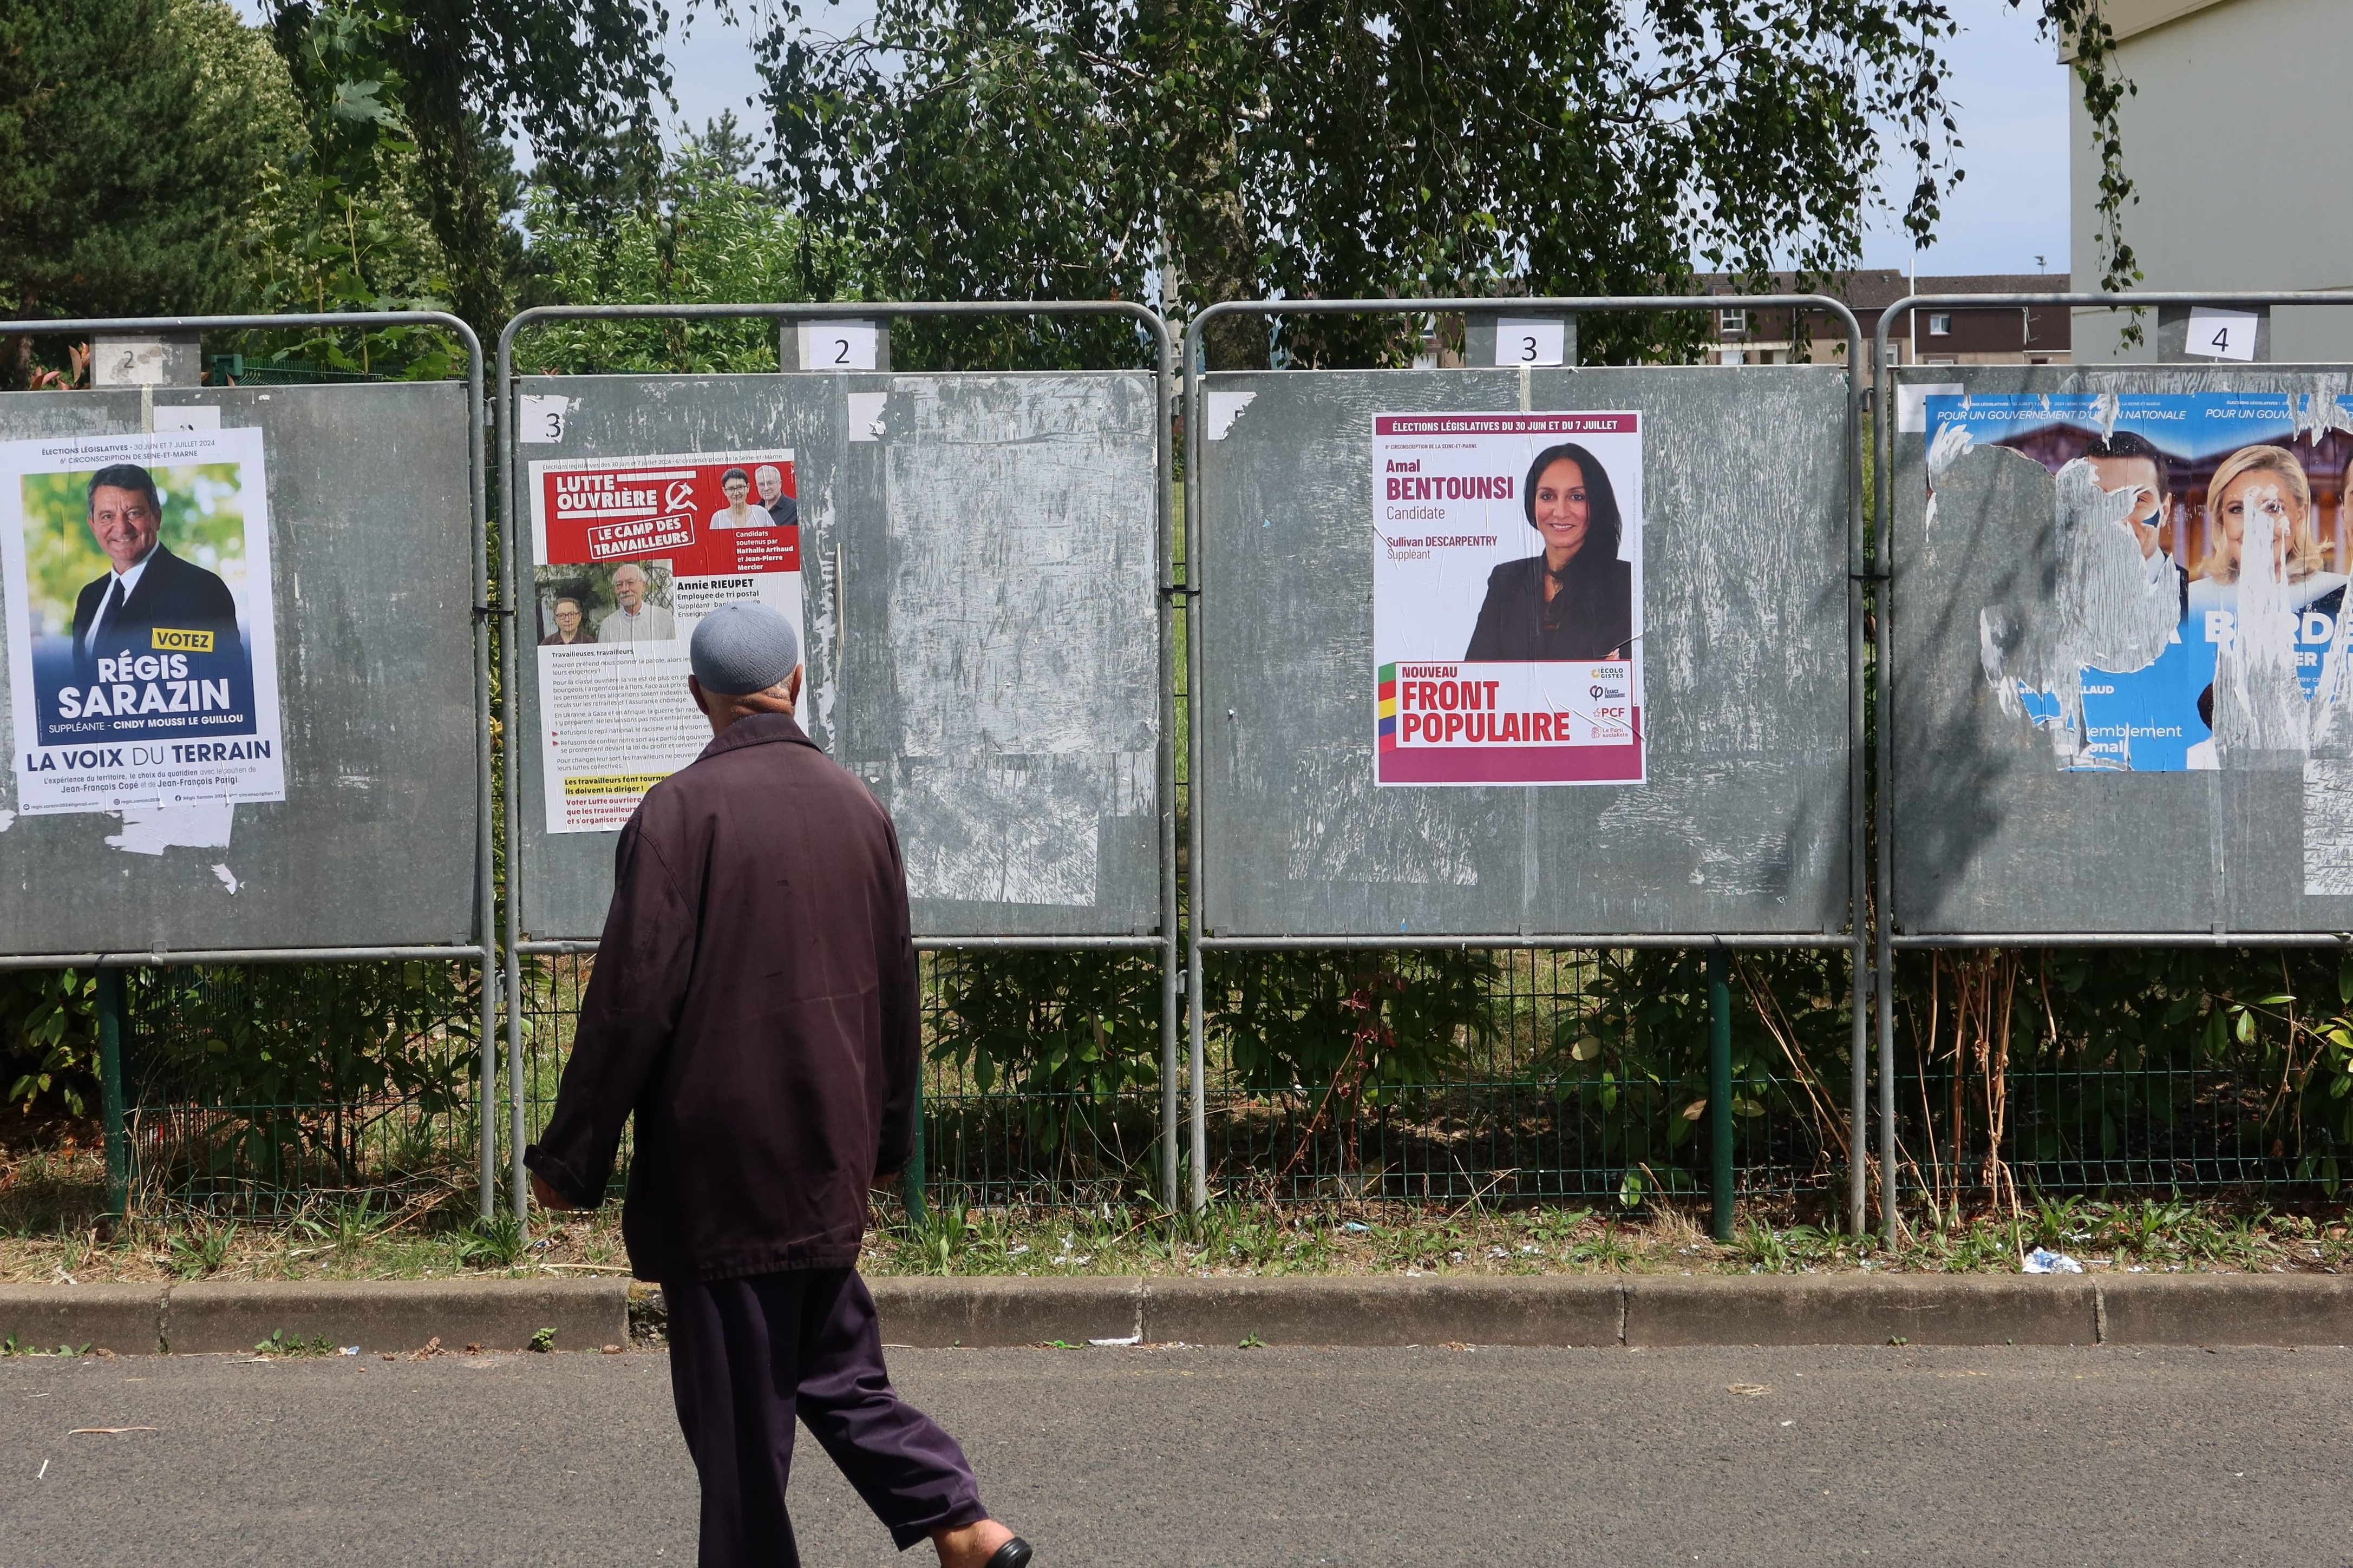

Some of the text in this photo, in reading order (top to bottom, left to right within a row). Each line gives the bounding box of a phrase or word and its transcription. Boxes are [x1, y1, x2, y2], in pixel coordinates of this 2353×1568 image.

[2211, 327, 2230, 352] 4
[834, 339, 850, 364] 2
[1522, 336, 1537, 362] 3
[123, 351, 134, 369] 2
[1937, 410, 2186, 420] POUR UN GOUVERNEMENT NATIONALE
[2205, 409, 2254, 418] POUR UN
[546, 413, 561, 438] 3
[1393, 420, 1618, 432] ÉLECTIONS LÉGISLATIVES DU 30 JUIN ET DU 7 JUILLET
[42, 447, 79, 456] ÉLECTIONS
[81, 444, 128, 454] LÉGISLATIVES
[68, 454, 131, 464] CIRCONSCRIPTION
[143, 450, 198, 460] SEINE-ET-MARNE
[1386, 459, 1421, 473] Amal
[557, 474, 615, 493] LUTTE
[1387, 476, 1513, 500] BENTOUNSI
[557, 487, 657, 510] OUVRIÈRE
[1387, 506, 1445, 520] Candidate
[598, 517, 681, 541] LE CAMP DES
[594, 531, 689, 555] TRAVAILLEURS
[1387, 536, 1498, 547] Sullivan DESCARPENTRY
[736, 546, 764, 555] Nathalie
[1387, 549, 1430, 562] Suppléant
[677, 579, 754, 591] Annie RIEUPET
[677, 593, 714, 602] Employée
[736, 590, 759, 599] postal
[677, 602, 710, 611] Suppléant
[157, 632, 209, 648] VOTEZ
[98, 649, 188, 683] RÉGIS
[1402, 666, 1457, 678] NOUVEAU
[58, 678, 230, 718] SARAZIN
[1402, 680, 1499, 710] FRONT
[1602, 707, 1625, 717] PCF
[49, 714, 243, 733] SUPPLÉANTE CINDY MOUSSI LE GUILLOU
[1402, 712, 1570, 742] POPULAIRE
[27, 740, 270, 771] LA VOIX DU TERRAIN
[44, 776, 84, 784] L'expérience
[97, 772, 127, 781] territoire,
[168, 770, 198, 778] quotidien
[578, 777, 621, 785] travailleurs
[61, 783, 115, 793] Jean-François
[119, 782, 139, 790] Copé
[158, 777, 212, 787] Jean-François
[614, 785, 639, 793] diriger
[576, 816, 617, 824] s'organiser
